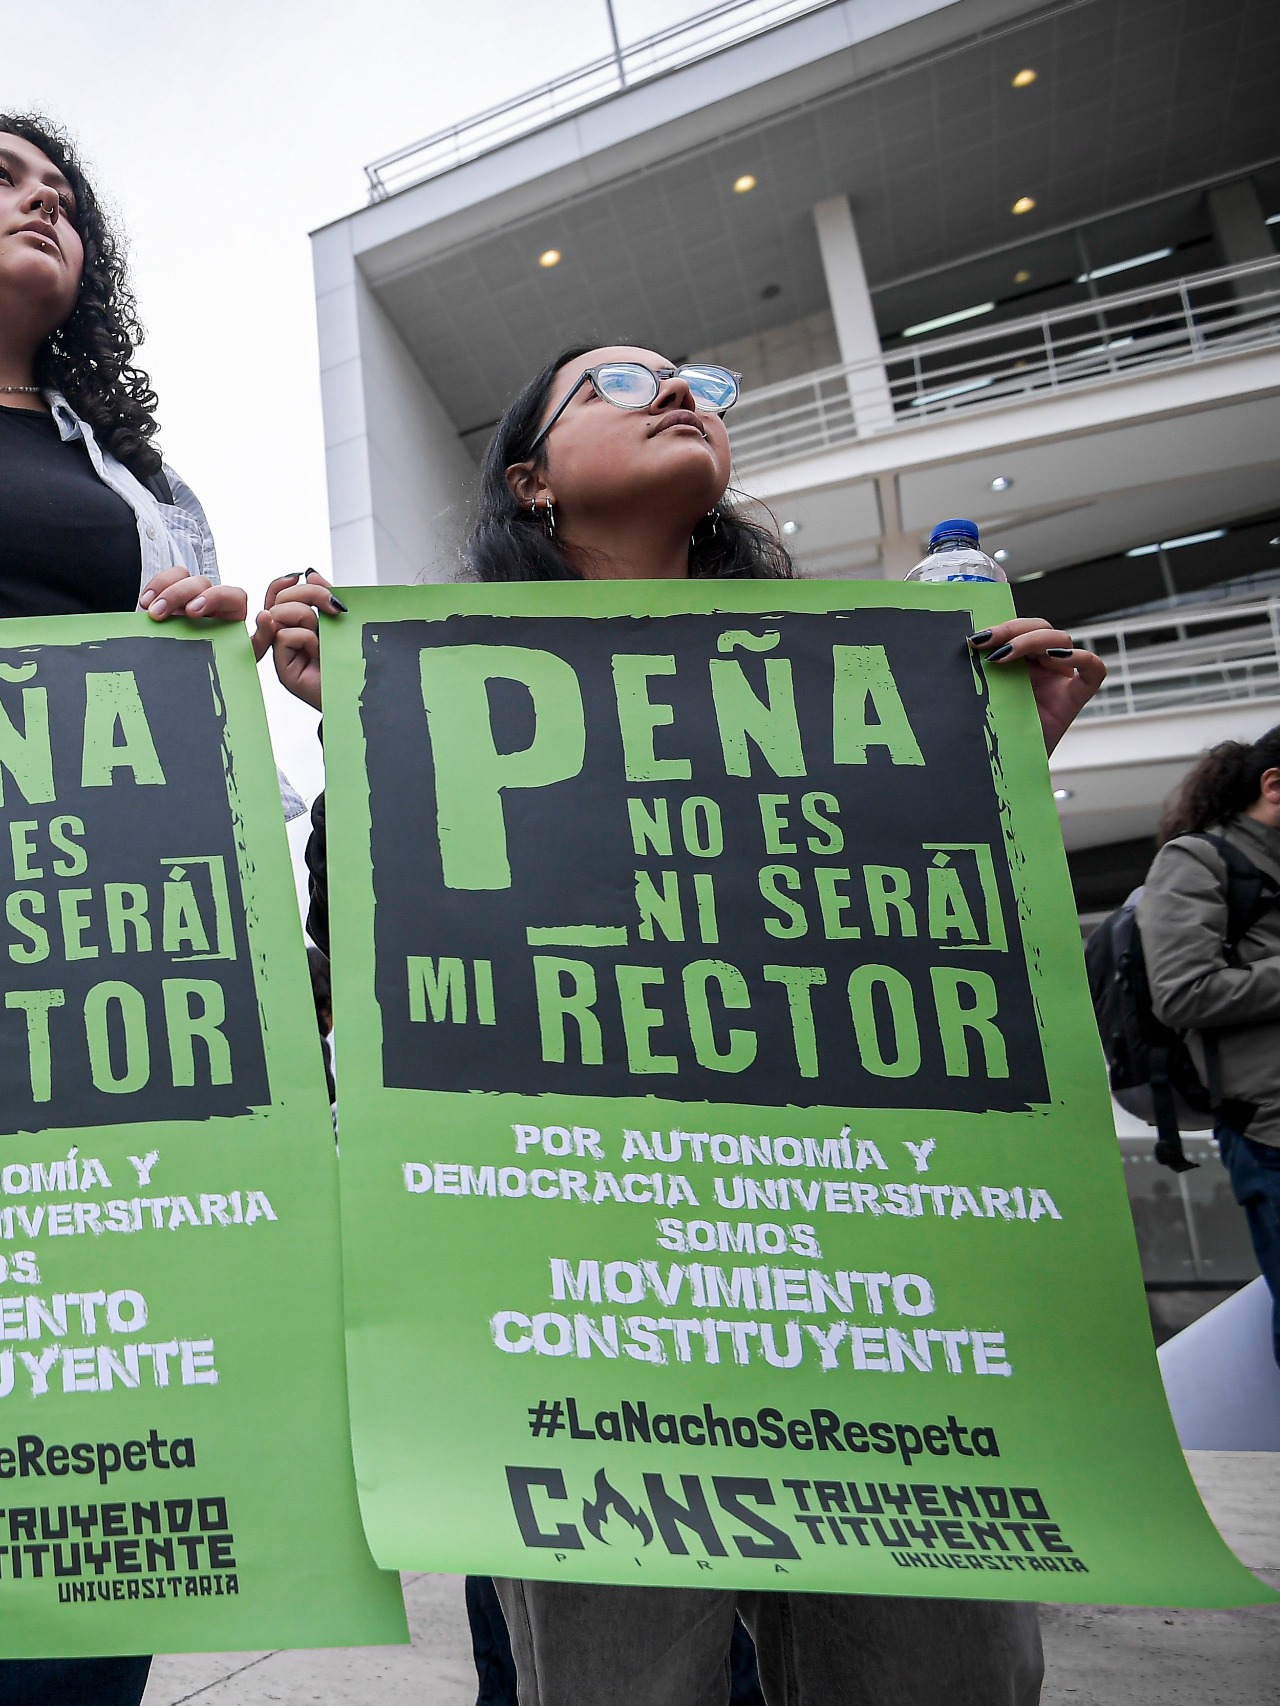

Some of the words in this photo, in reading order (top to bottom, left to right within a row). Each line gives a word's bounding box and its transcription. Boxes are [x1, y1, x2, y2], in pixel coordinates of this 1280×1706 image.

[419, 630, 926, 890] PEÑA
[10, 816, 88, 881] ES
[626, 795, 721, 857] NO
[760, 791, 844, 855] ES
[6, 865, 210, 964] SERÁ
[634, 869, 718, 944] NI
[759, 851, 980, 941] SERÁ
[407, 956, 496, 1026] MI
[533, 955, 1009, 1079] RECTOR
[128, 1151, 159, 1186] Y
[512, 1124, 602, 1161] POR
[622, 1126, 888, 1172] AUTONOMÍA
[904, 1138, 936, 1174] Y
[402, 1162, 700, 1208] DEMOCRACIA
[713, 1176, 1062, 1222] UNIVERSITARIA
[656, 1218, 823, 1260] SOMOS
[550, 1256, 937, 1318] MOVIMIENTO
[489, 1310, 1012, 1378] CONSTITUYENTE
[528, 1397, 1000, 1466] #LaNachoSeRespeta
[782, 1478, 1050, 1520] TRUYENDO
[795, 1514, 1074, 1553] TITUYENTE
[891, 1551, 1089, 1573] UNIVERSITARIA
[58, 1574, 239, 1602] UNIVERSITARIA
